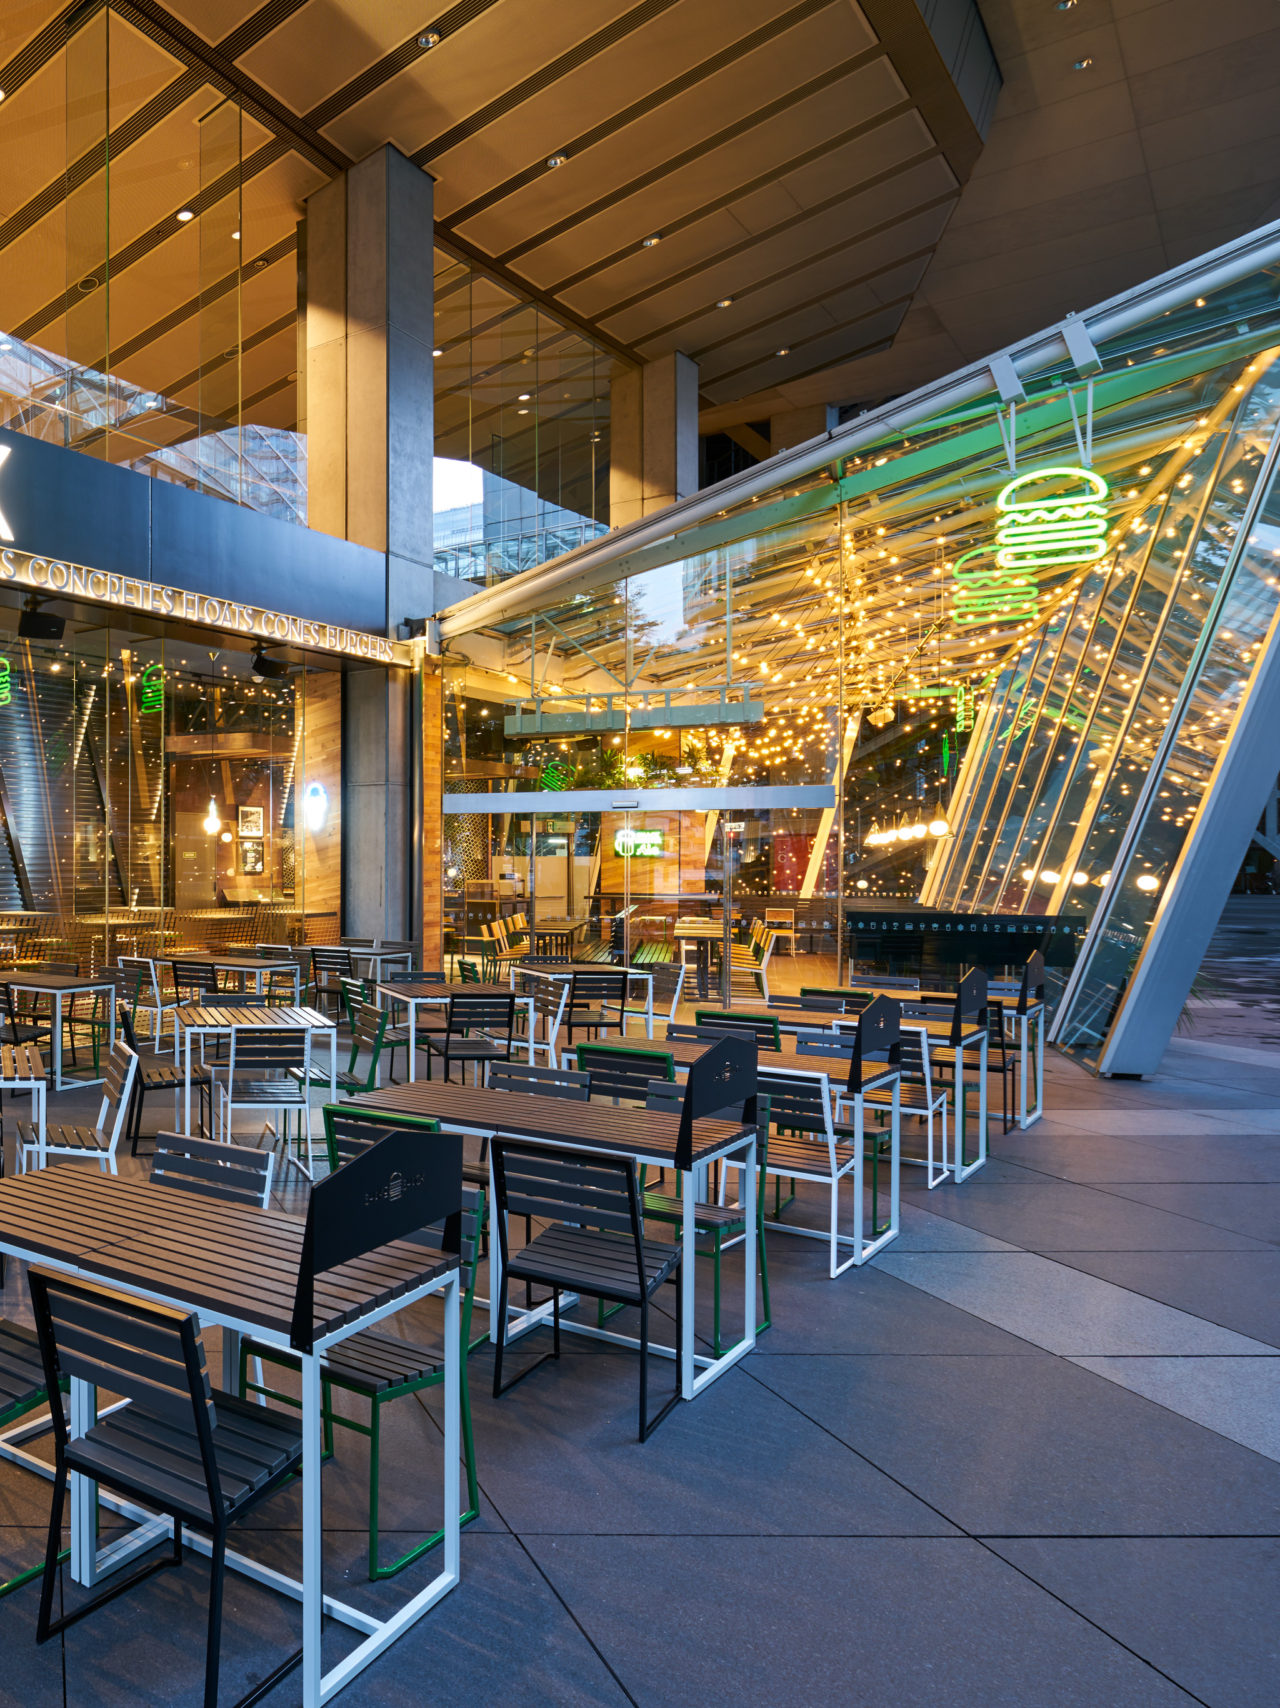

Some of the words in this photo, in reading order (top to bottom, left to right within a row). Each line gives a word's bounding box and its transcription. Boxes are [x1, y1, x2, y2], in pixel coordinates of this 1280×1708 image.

[29, 557, 174, 615] CONCRETES
[184, 592, 254, 632] FLOATS
[261, 611, 320, 646] CONES
[326, 625, 394, 662] BURGERS
